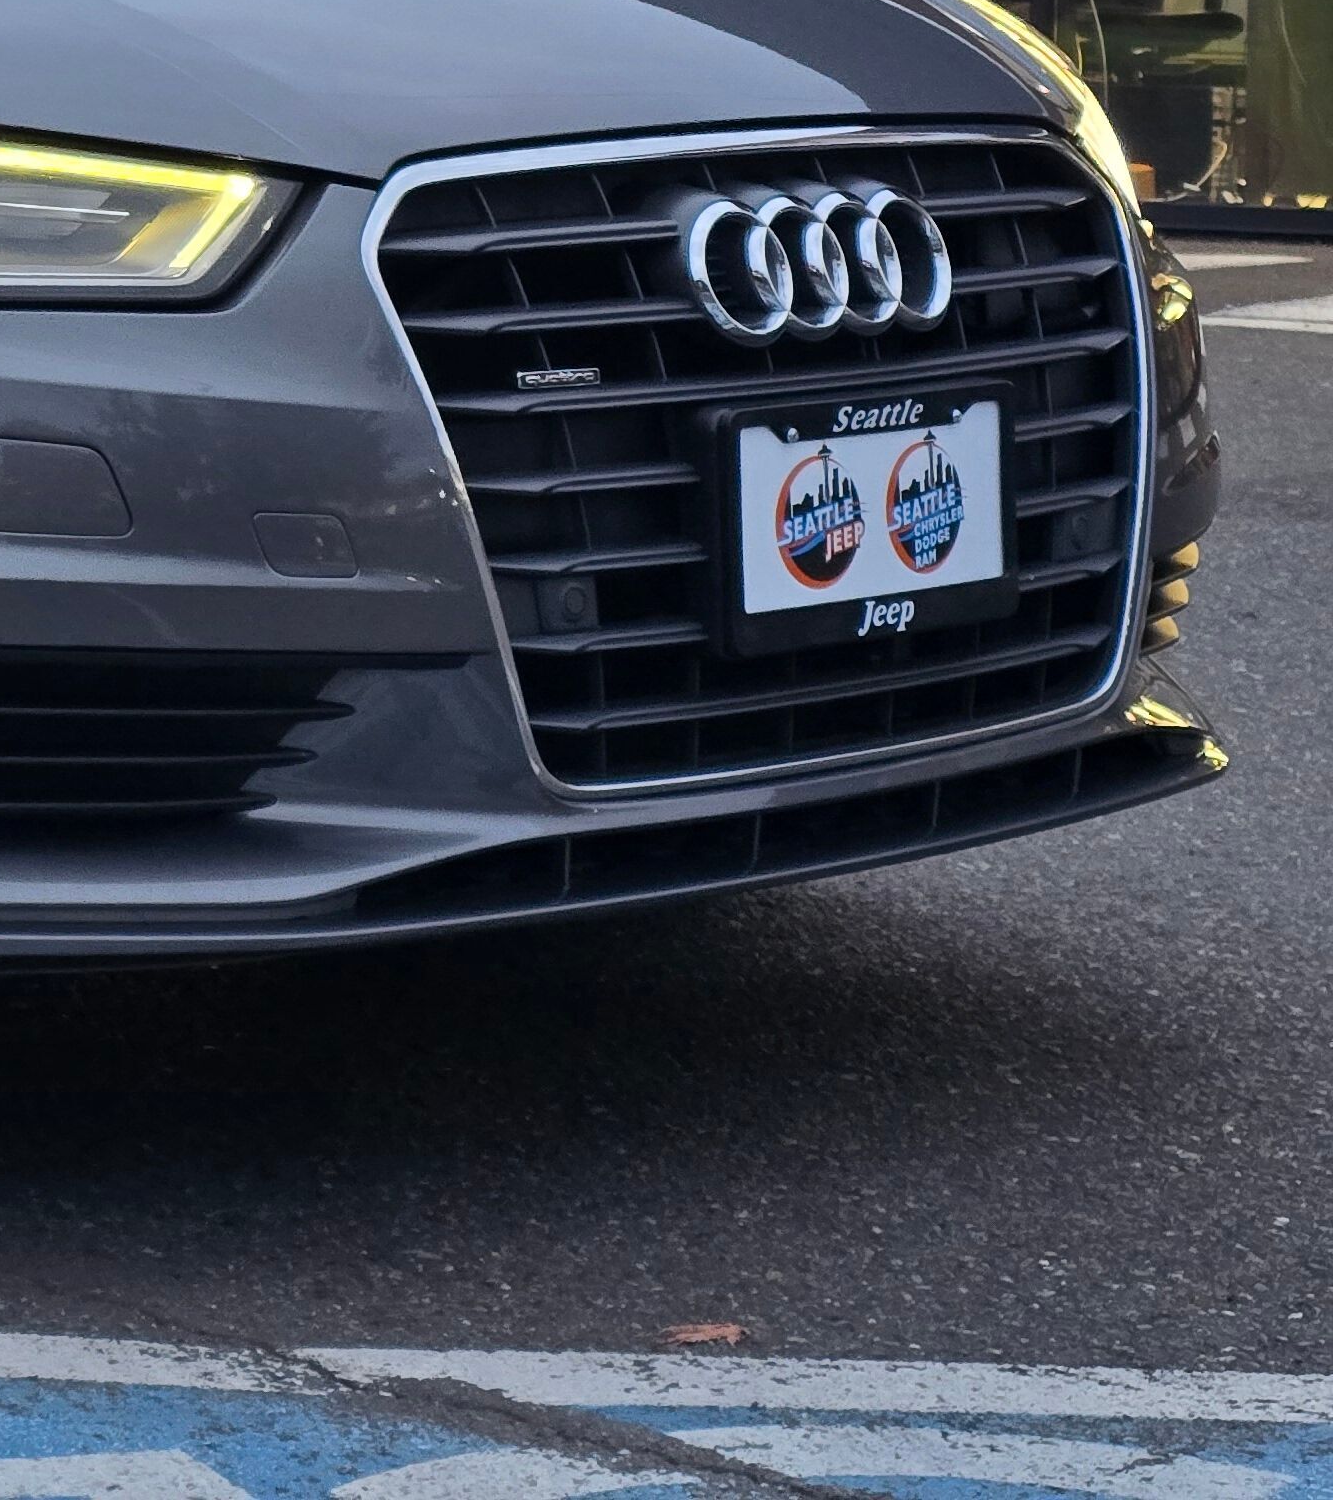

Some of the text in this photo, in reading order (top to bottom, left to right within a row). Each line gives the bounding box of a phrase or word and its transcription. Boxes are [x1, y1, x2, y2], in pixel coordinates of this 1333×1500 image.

[832, 399, 924, 432] Seattle
[778, 498, 854, 546] SEATTLE
[889, 483, 956, 531] SEATTLE
[914, 505, 965, 537] CHRYSLER
[825, 520, 864, 563] JEEP
[915, 526, 950, 554] DODGE
[915, 548, 937, 569] RAM
[858, 599, 915, 637] Jeep
